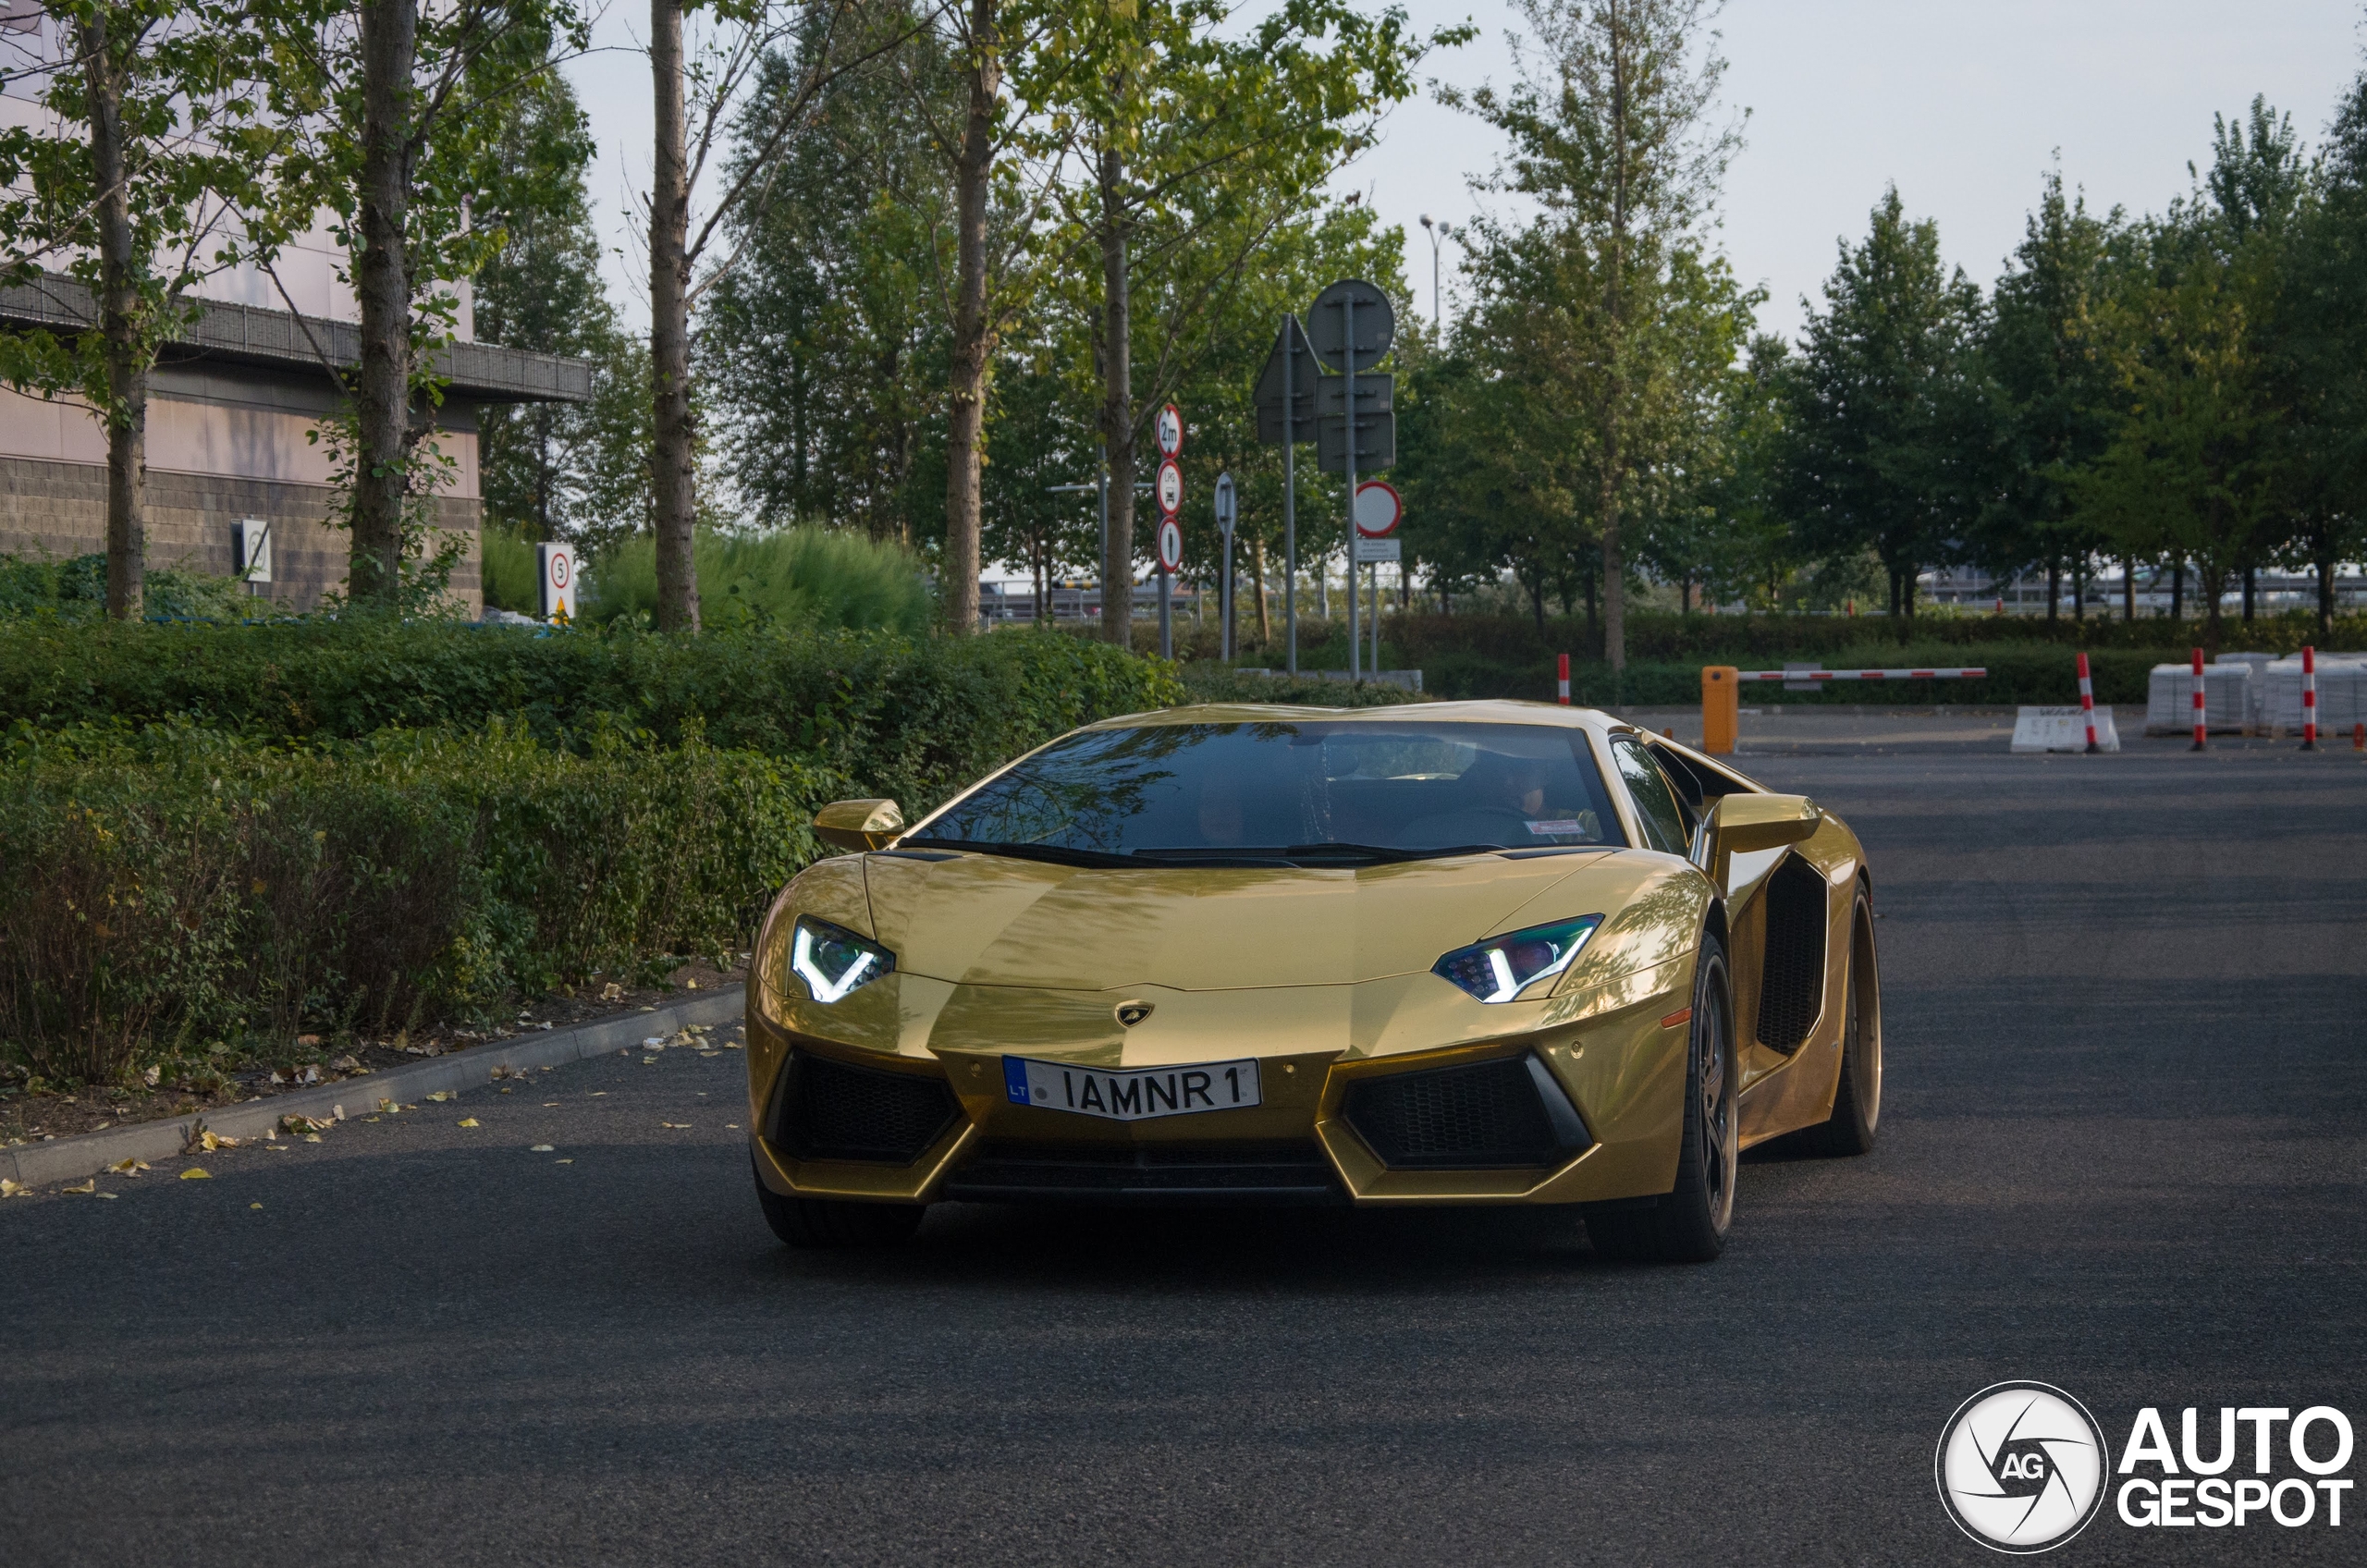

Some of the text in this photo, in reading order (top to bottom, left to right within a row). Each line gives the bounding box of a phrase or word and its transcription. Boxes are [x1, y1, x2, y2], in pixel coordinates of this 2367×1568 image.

[1165, 472, 1175, 482] LPG
[558, 563, 563, 579] 5
[1009, 1084, 1026, 1096] LT
